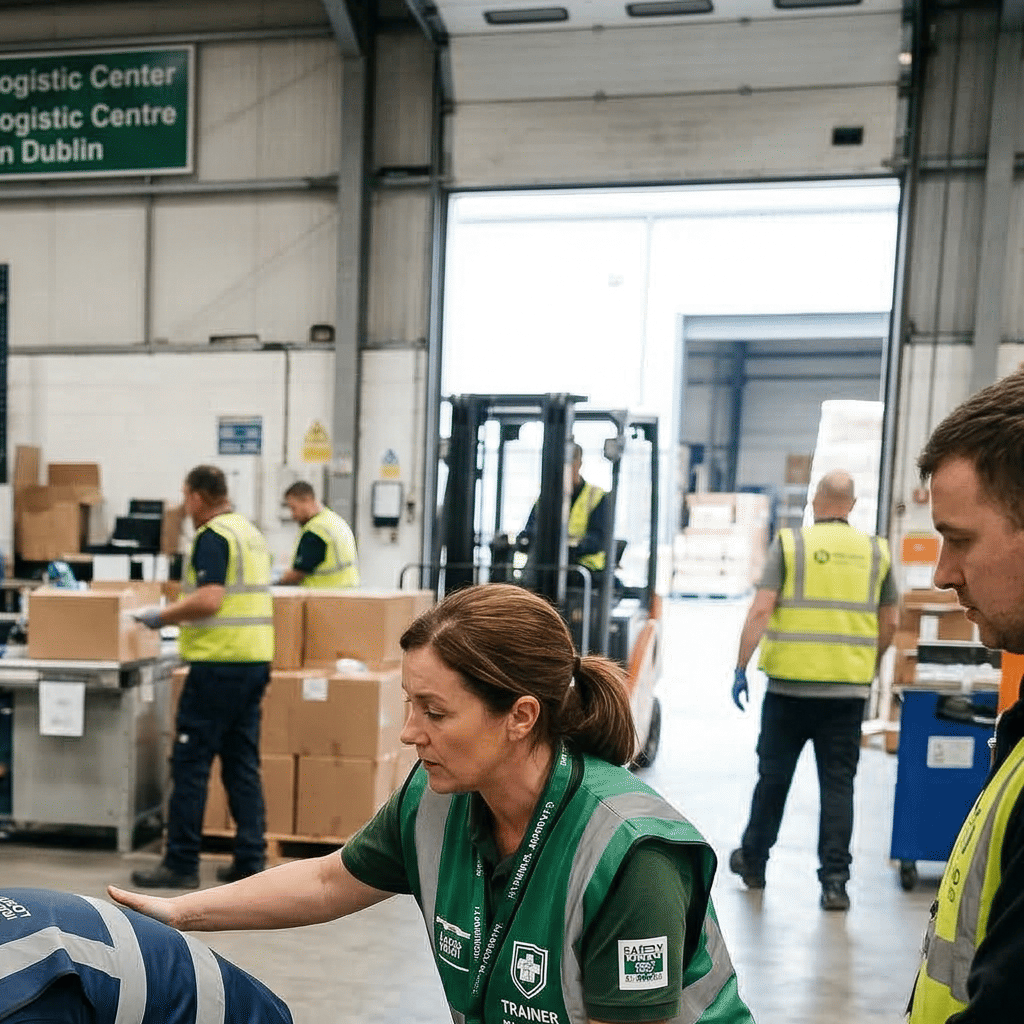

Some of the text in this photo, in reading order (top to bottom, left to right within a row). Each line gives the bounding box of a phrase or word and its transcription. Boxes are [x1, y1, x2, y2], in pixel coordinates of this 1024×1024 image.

[90, 63, 177, 89] Center
[91, 103, 177, 129] Centre
[21, 137, 104, 163] Dublin
[500, 998, 560, 1024] TRAINER
